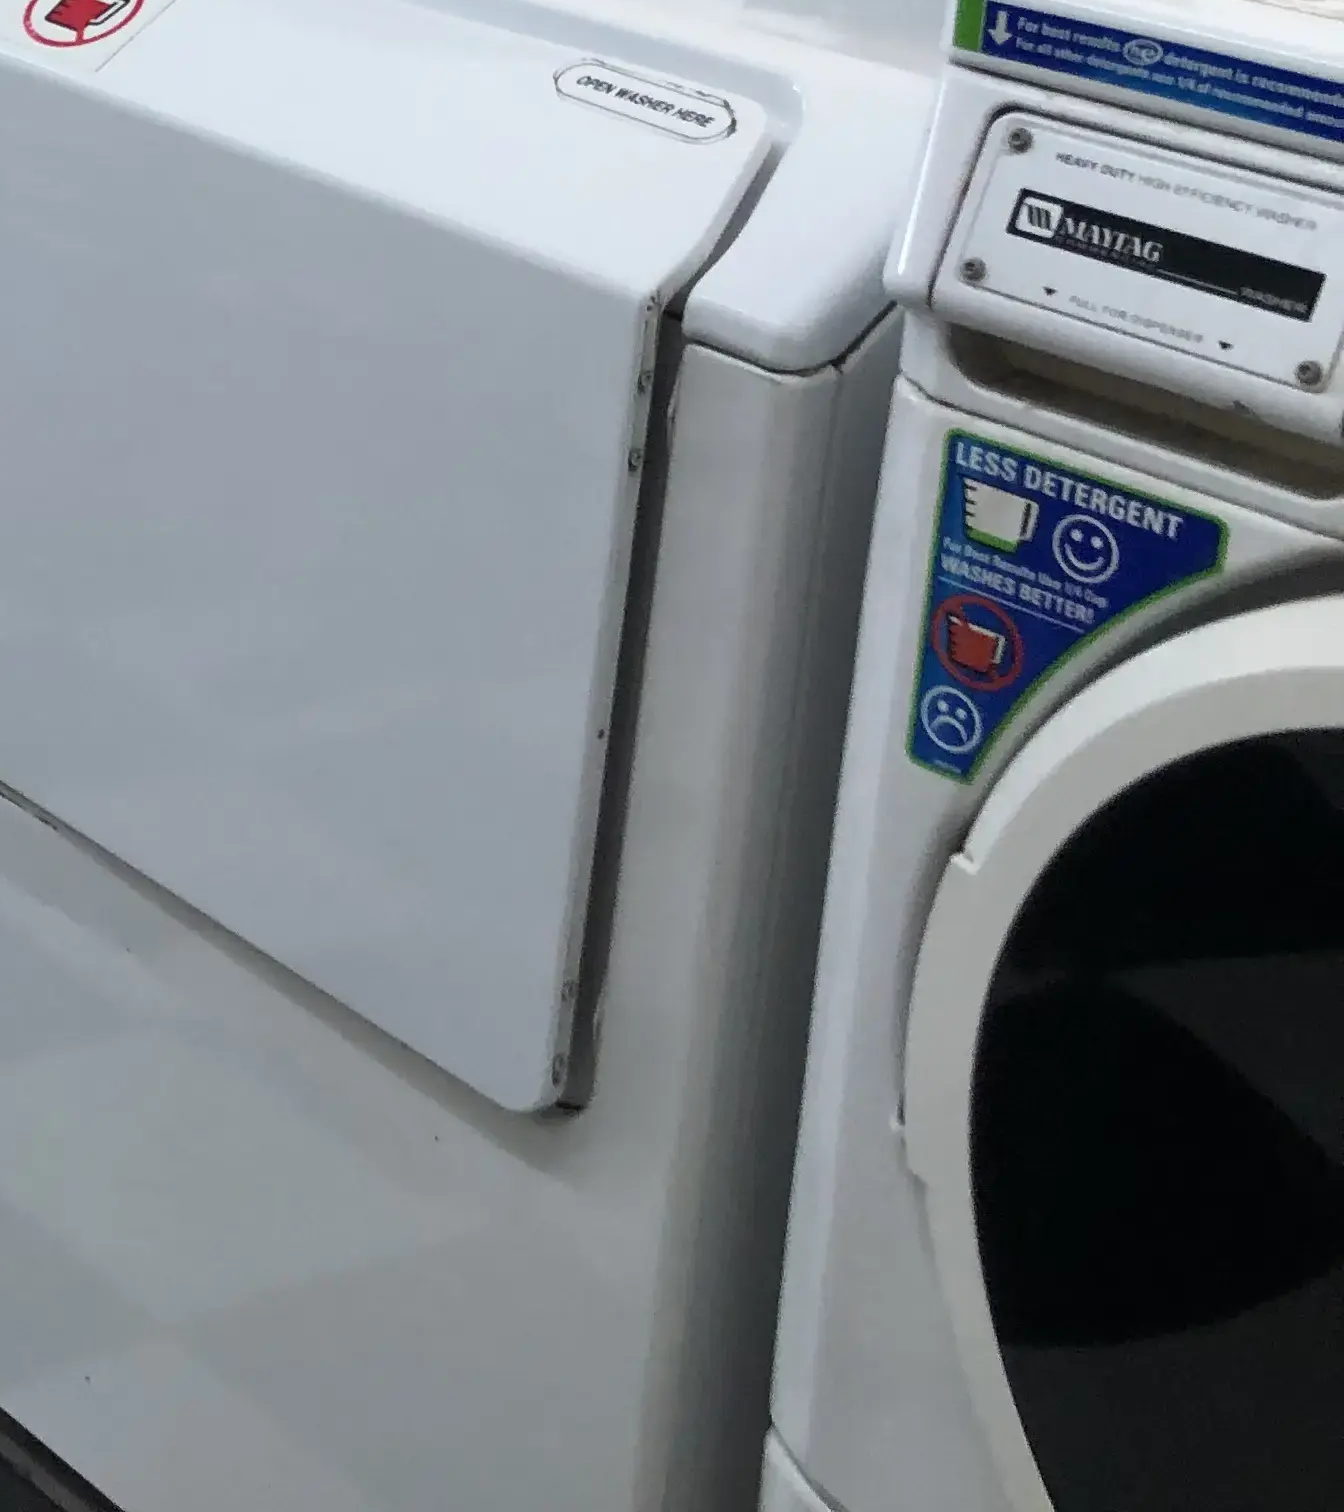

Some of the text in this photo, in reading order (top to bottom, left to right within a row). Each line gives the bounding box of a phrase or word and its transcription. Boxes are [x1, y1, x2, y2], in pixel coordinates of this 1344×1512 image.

[1016, 37, 1036, 52] For
[1036, 43, 1053, 55] all
[1054, 47, 1084, 63] other
[1213, 88, 1305, 118] recommended
[1017, 16, 1040, 33] For
[1041, 22, 1072, 41] best
[1072, 32, 1121, 52] results
[1164, 52, 1234, 80] detergent
[1235, 69, 1250, 84] is
[576, 75, 715, 128] OPEN WASHER HERE
[1056, 152, 1317, 231] HEAVY DUTY HIGH EFFICIENCY WASHER
[1061, 217, 1163, 263] MAYTAG
[1069, 295, 1204, 343] PULL FOR DISPENSER
[955, 442, 1183, 539] LESS DETERGENT
[941, 553, 1095, 624] WASHES BETTER!
